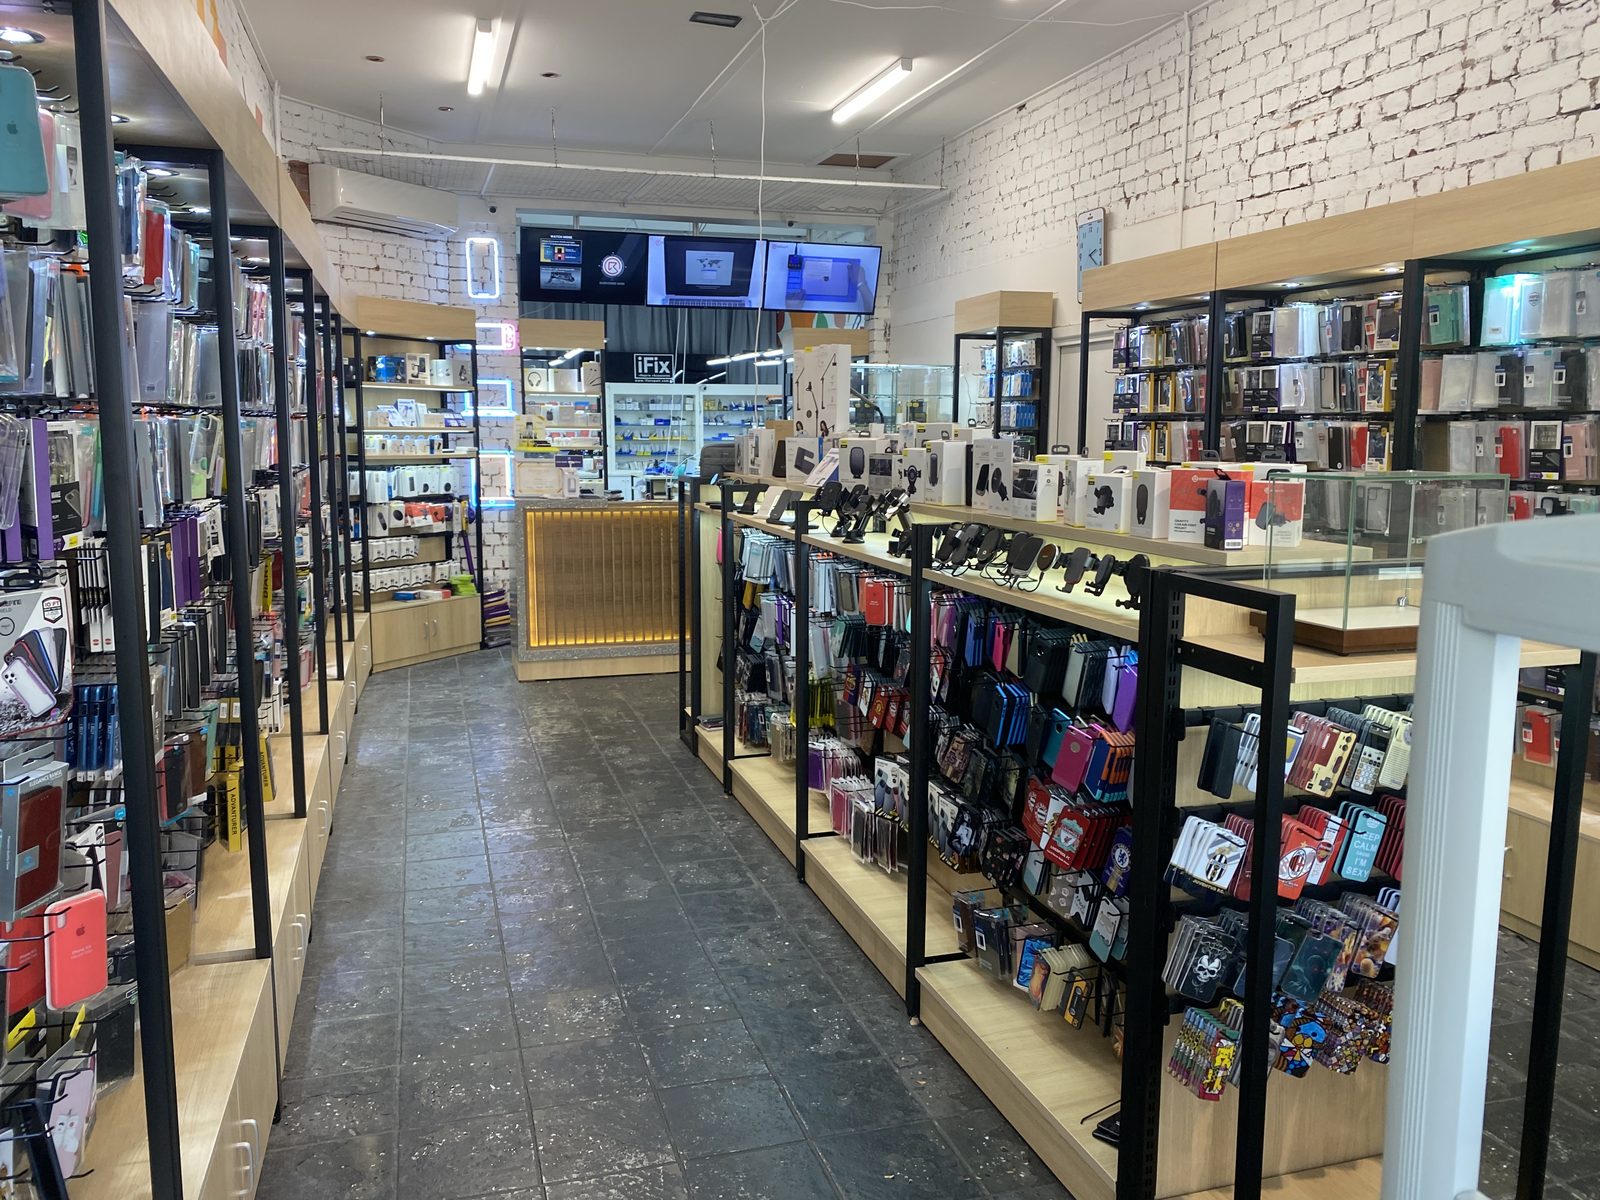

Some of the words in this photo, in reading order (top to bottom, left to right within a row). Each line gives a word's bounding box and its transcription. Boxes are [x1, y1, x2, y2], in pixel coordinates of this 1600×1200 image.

[637, 356, 671, 374] iFix
[1354, 840, 1378, 852] CALM
[1355, 858, 1367, 866] I'M
[1346, 866, 1370, 878] SEXY
